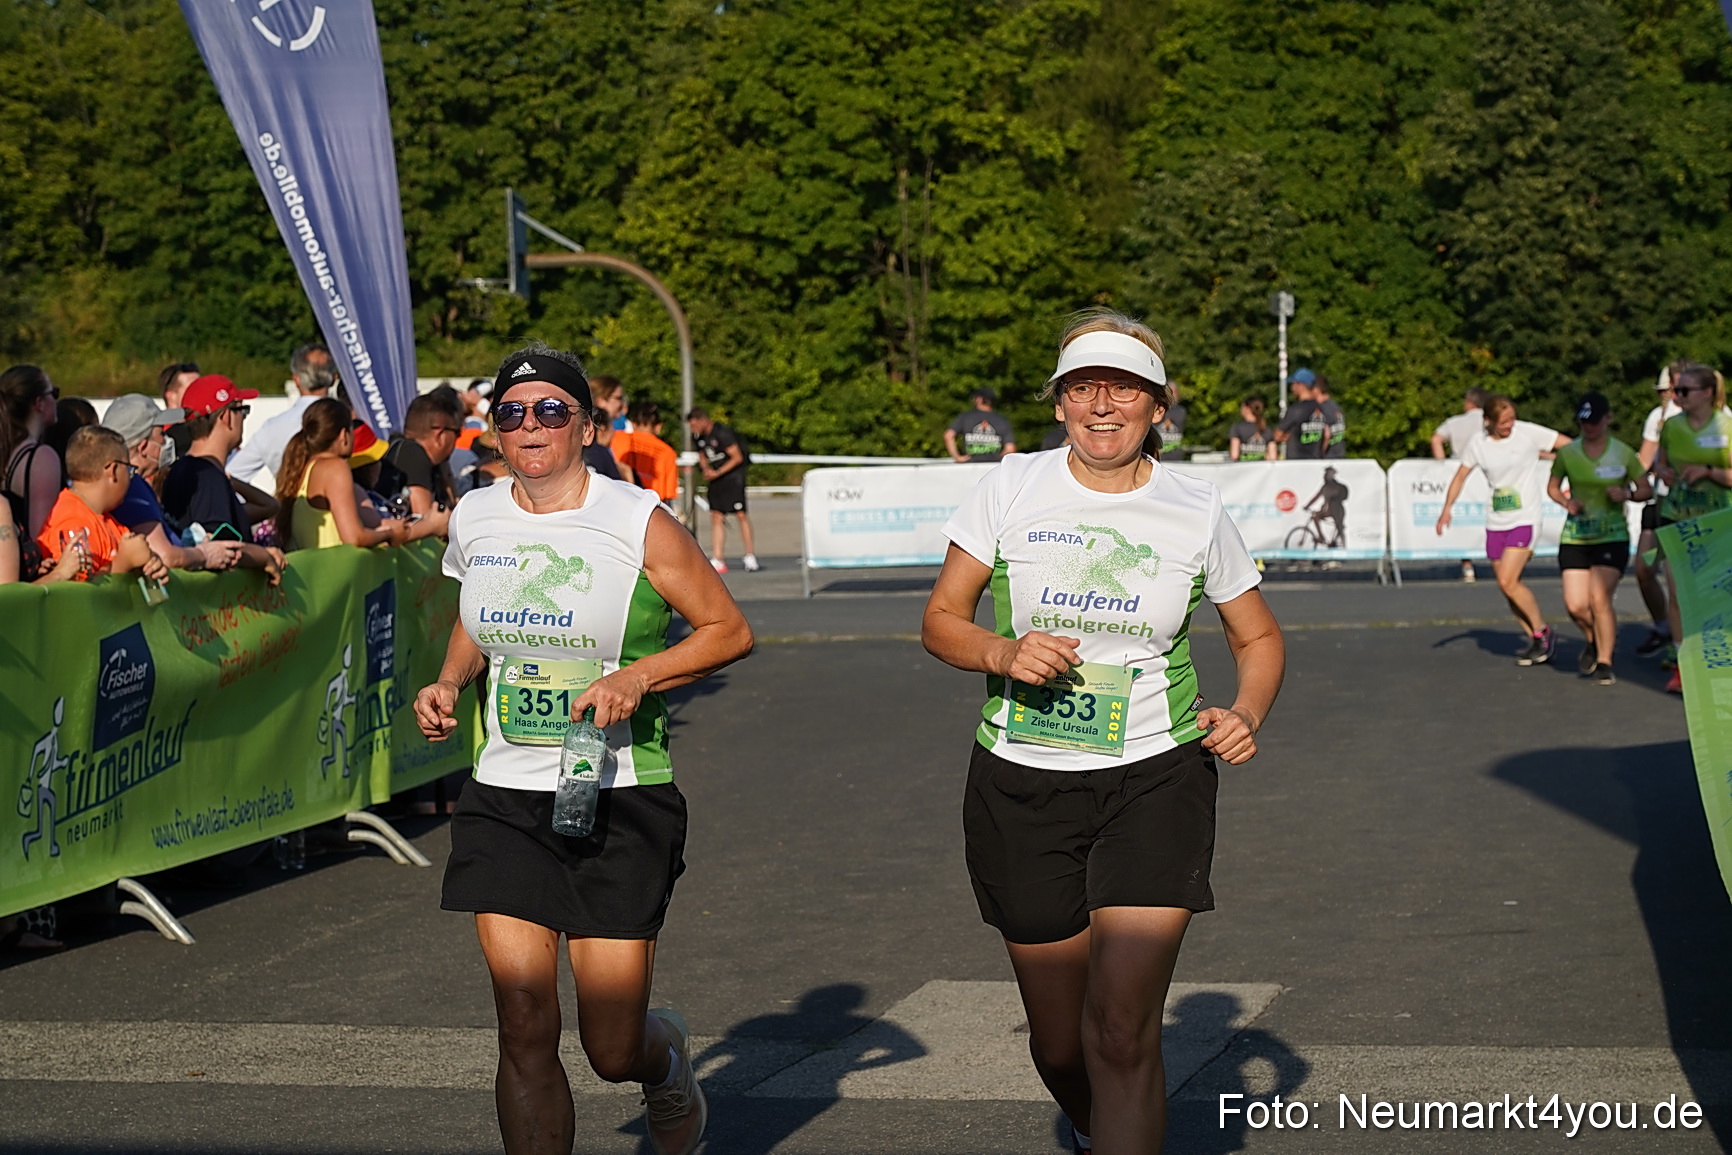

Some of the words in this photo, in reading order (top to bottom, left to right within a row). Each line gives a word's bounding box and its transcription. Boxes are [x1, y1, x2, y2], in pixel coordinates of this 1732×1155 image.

[1028, 532, 1083, 545] BERATA
[473, 556, 517, 567] BERATA
[1040, 587, 1140, 613] Laufend
[480, 607, 573, 627] Laufend
[1031, 614, 1154, 639] erfolgreich
[478, 630, 597, 649] erfolgreich
[107, 662, 148, 691] Fischer
[109, 682, 145, 699] AUTOMOBILE
[518, 687, 569, 717] 351
[501, 694, 509, 724] RUN
[1014, 691, 1027, 723] RUN
[1037, 686, 1097, 722] 353
[514, 716, 539, 728] Haas
[540, 719, 572, 731] Angel
[1031, 715, 1061, 730] Zisler
[1062, 721, 1099, 736] Ursula
[1107, 700, 1123, 742] 2022
[66, 699, 197, 816] firmenlauf
[66, 803, 124, 845] neumarkt
